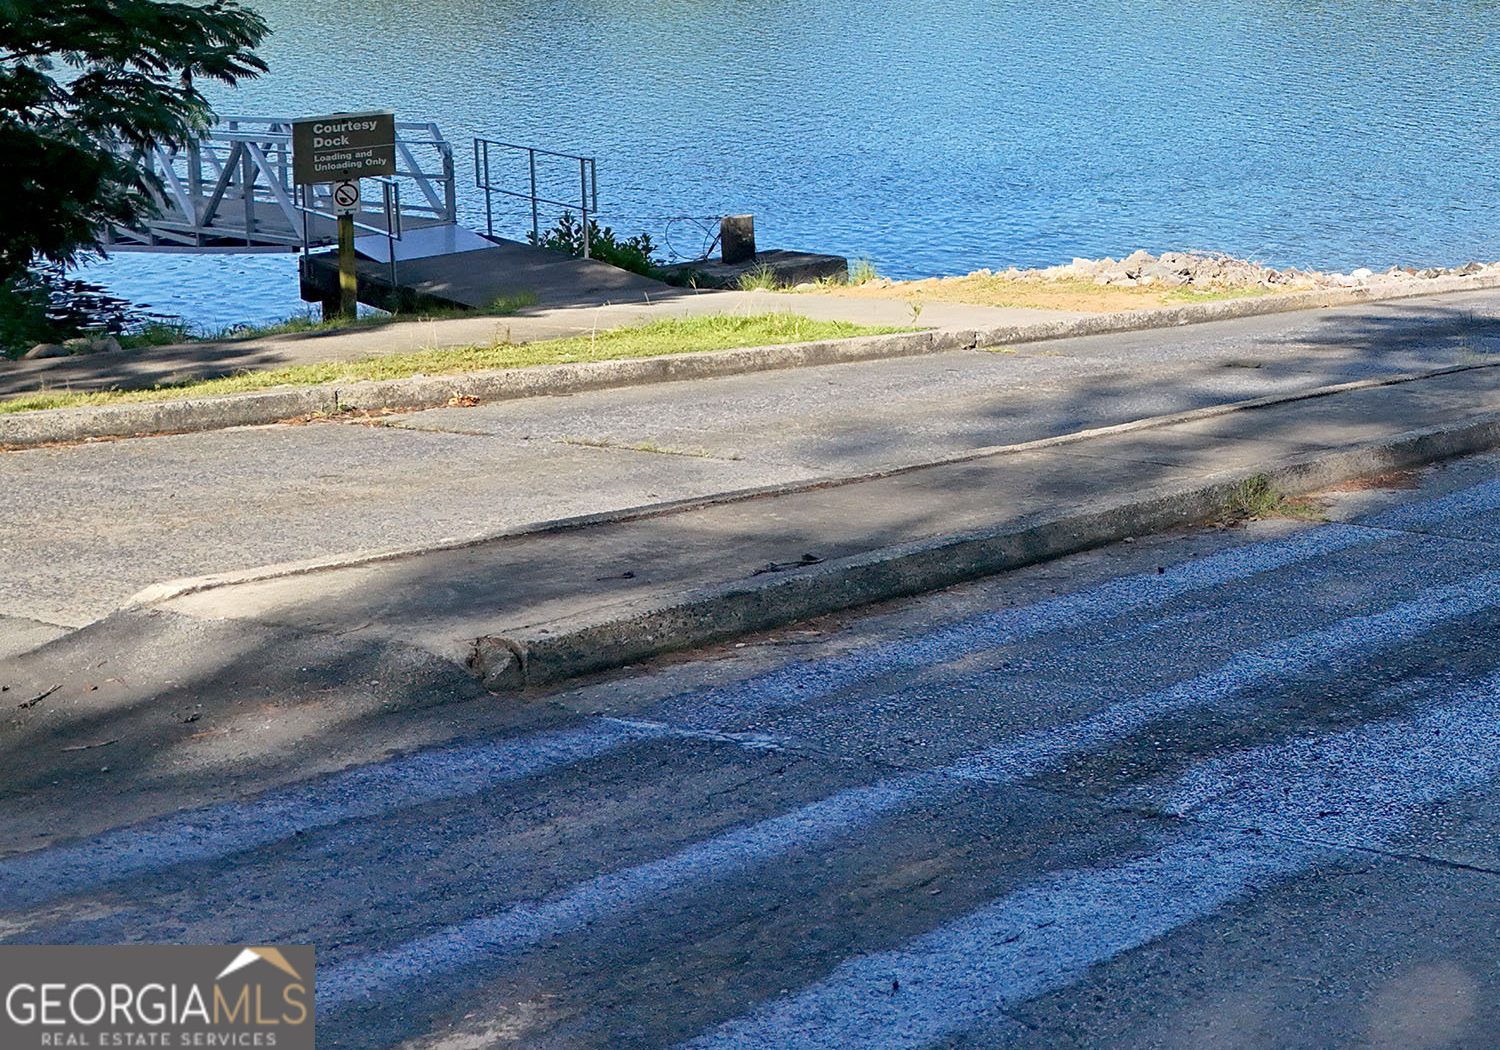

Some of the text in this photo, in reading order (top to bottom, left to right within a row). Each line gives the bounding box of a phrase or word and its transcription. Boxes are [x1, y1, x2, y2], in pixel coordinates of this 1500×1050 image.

[313, 120, 377, 134] Courtesy
[313, 135, 349, 148] Dock
[314, 150, 372, 162] Loading and
[314, 158, 387, 171] Unloading Only
